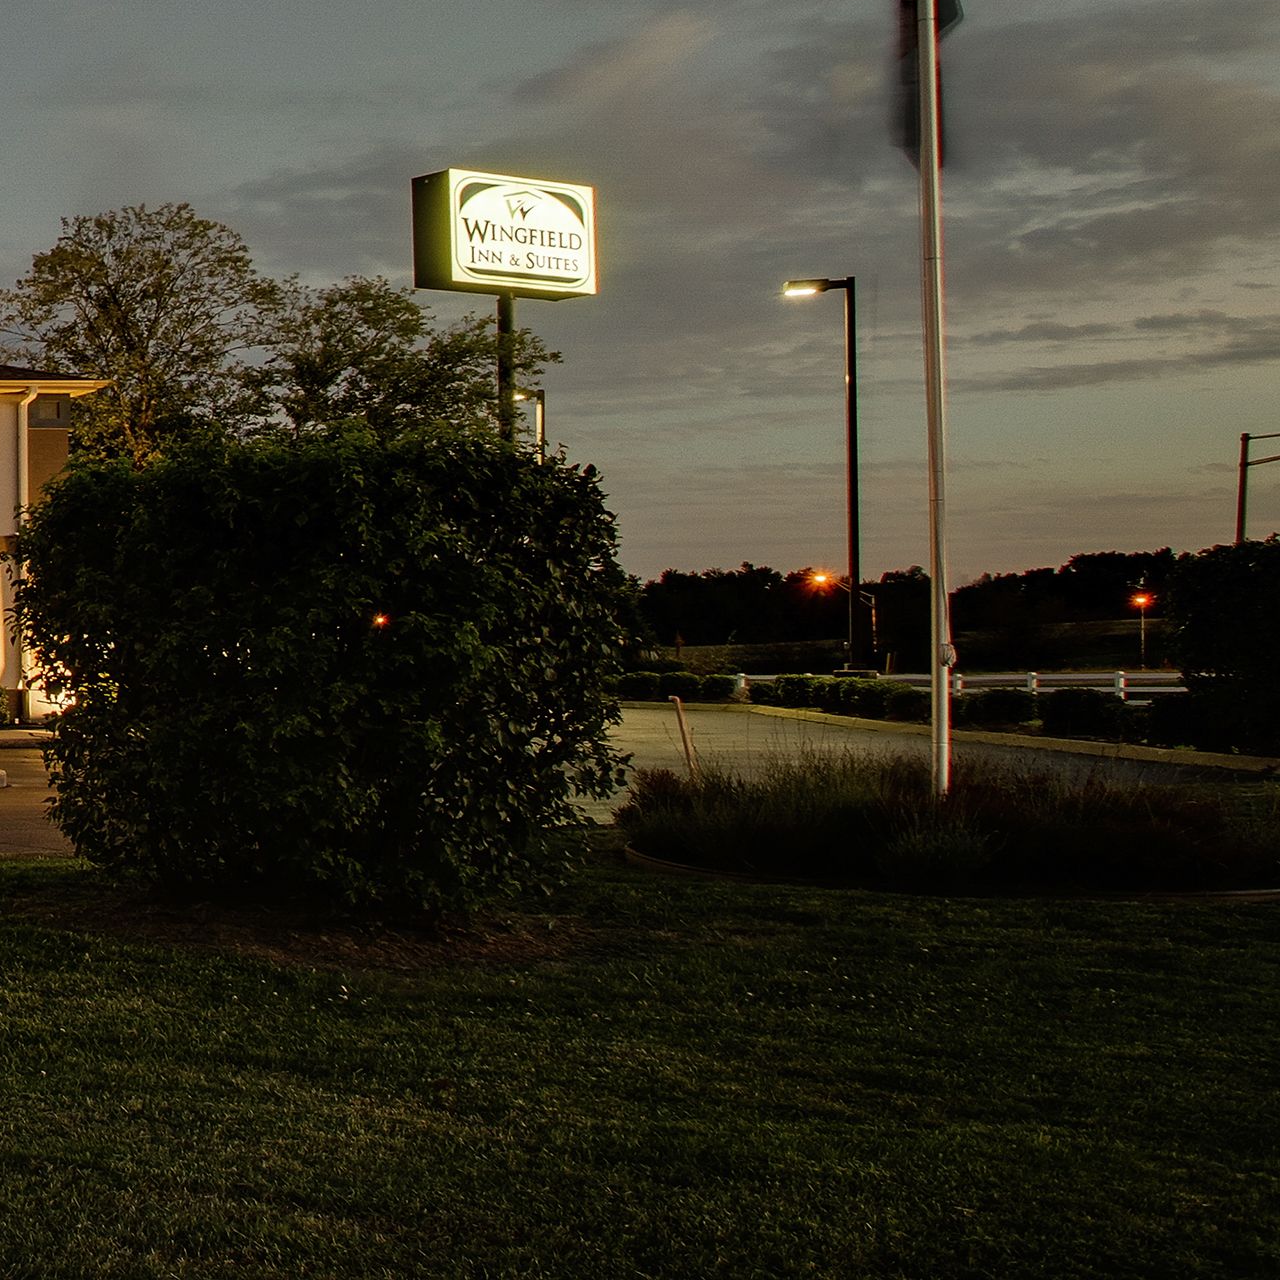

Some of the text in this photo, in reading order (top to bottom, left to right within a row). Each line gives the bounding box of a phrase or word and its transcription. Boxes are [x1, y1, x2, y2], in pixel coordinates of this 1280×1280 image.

[462, 217, 582, 250] WINGFIELD
[470, 246, 579, 272] INN & SUITES
